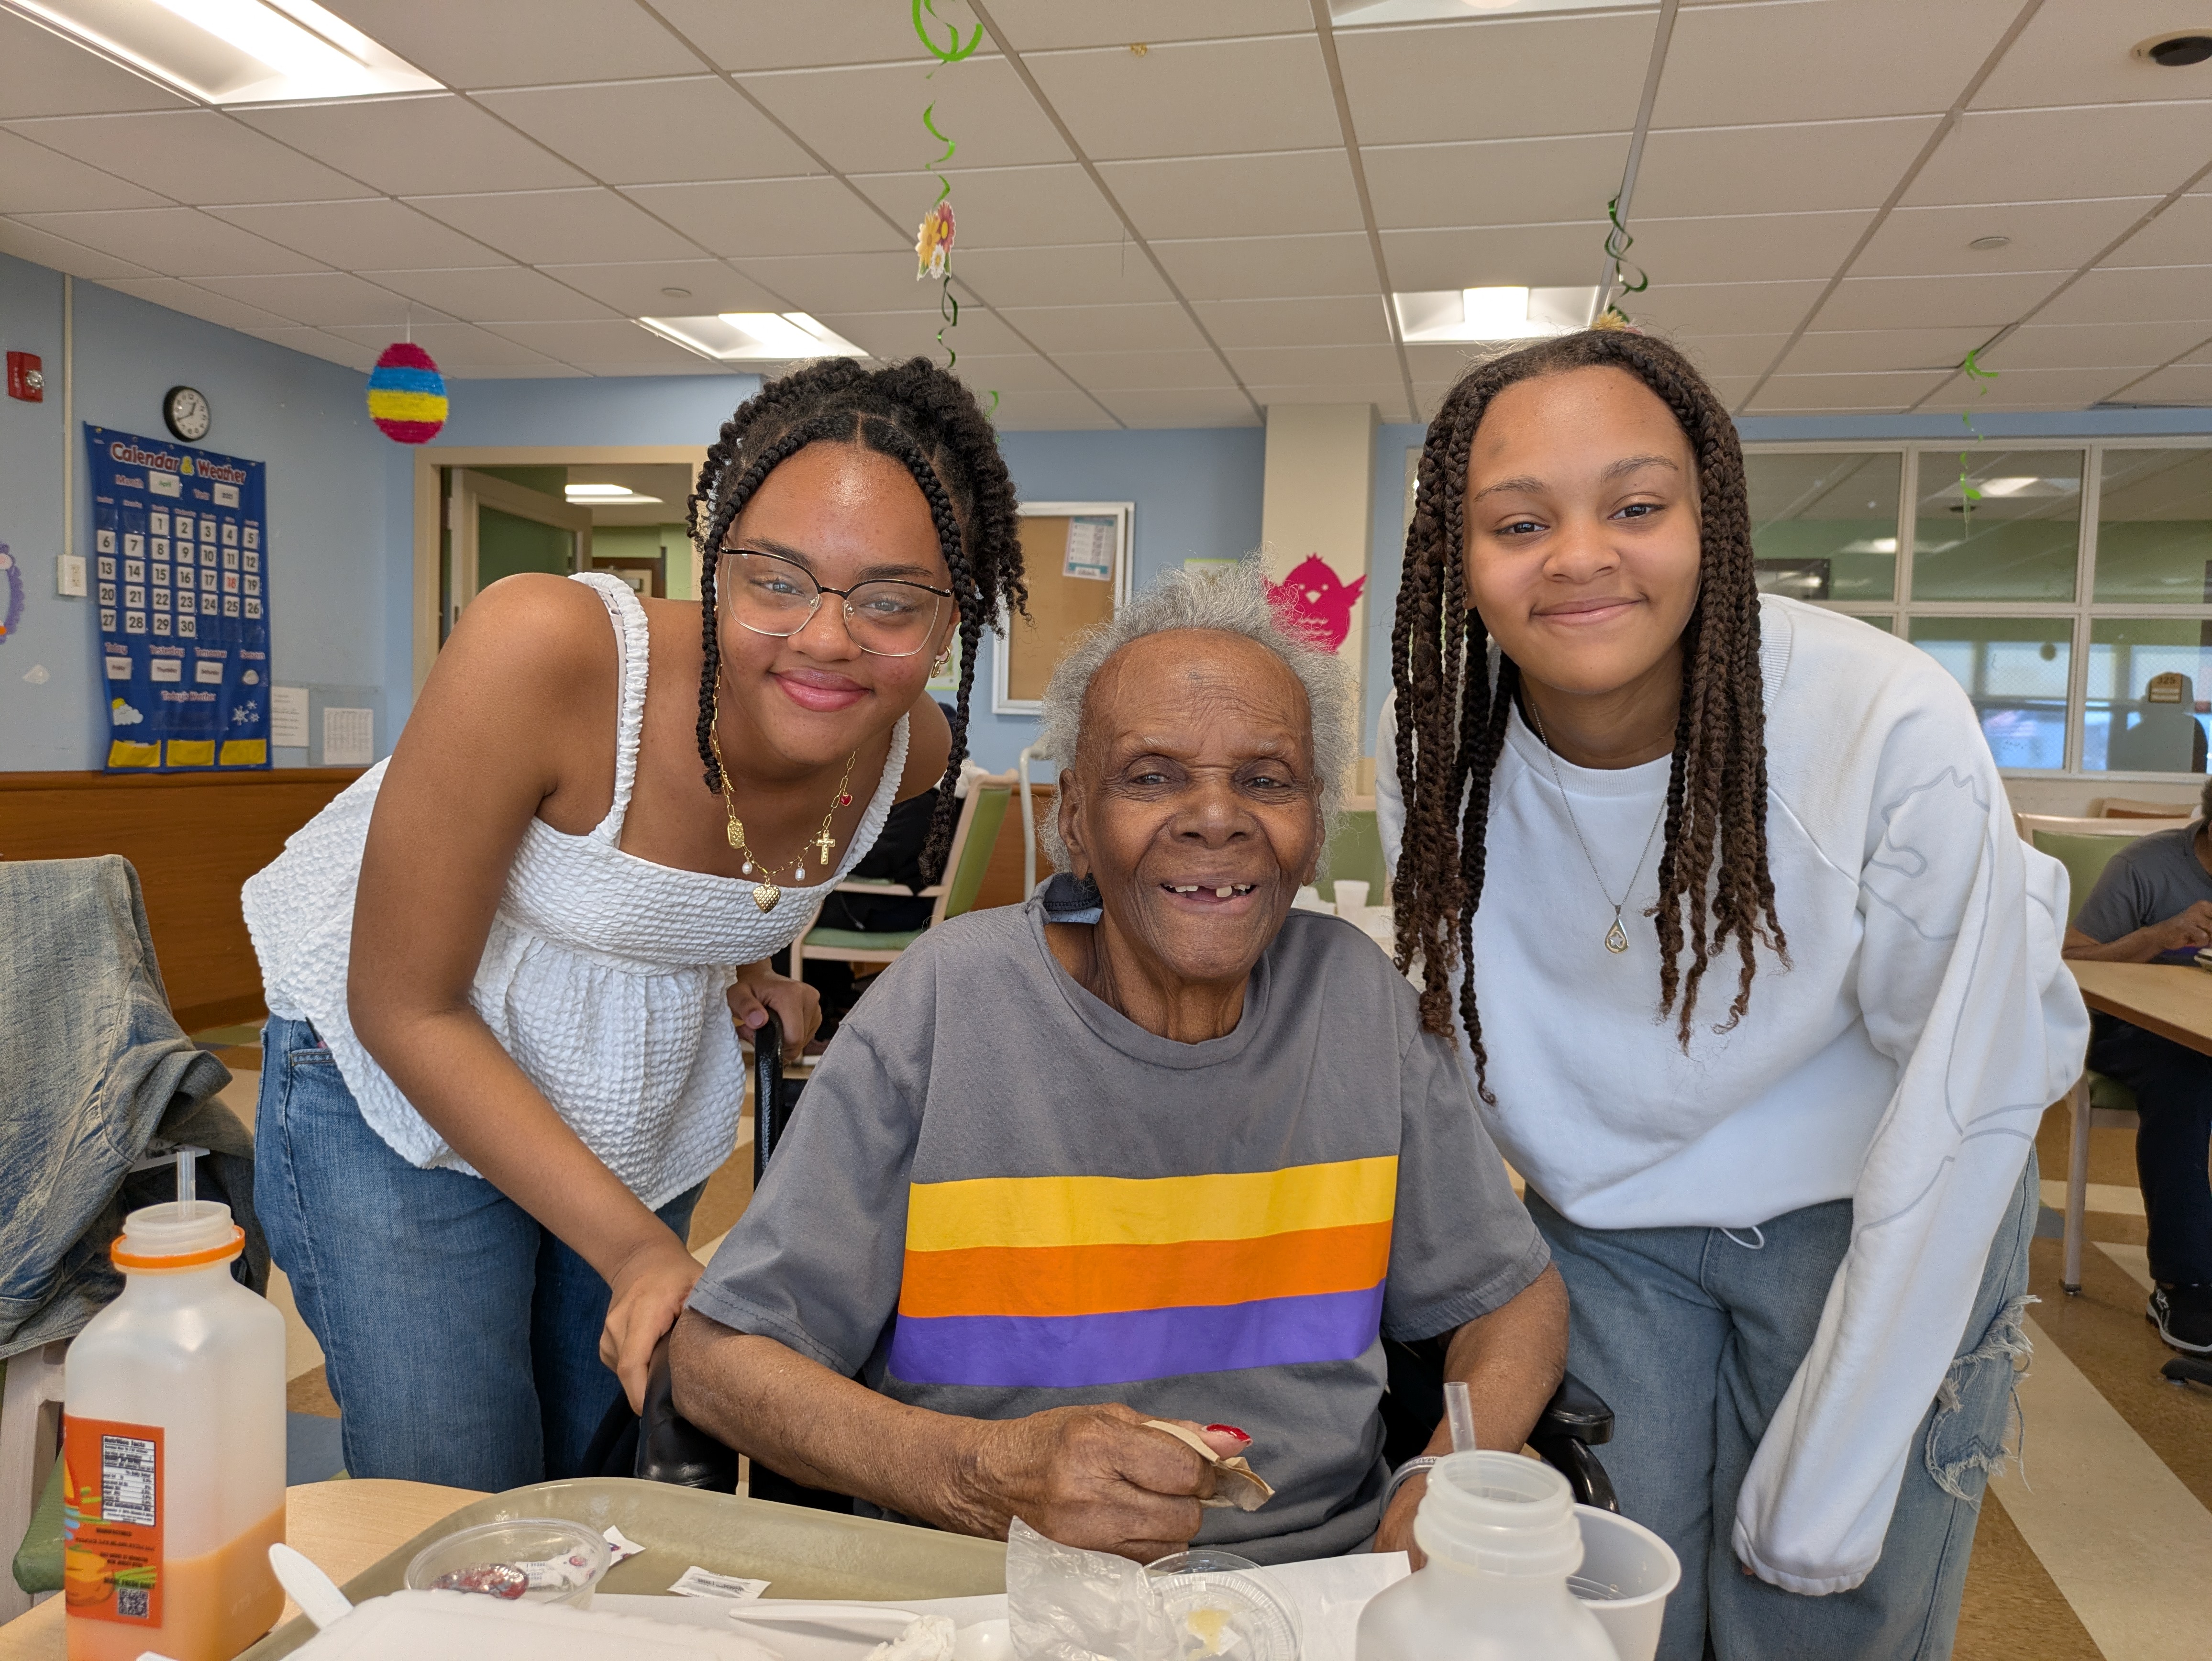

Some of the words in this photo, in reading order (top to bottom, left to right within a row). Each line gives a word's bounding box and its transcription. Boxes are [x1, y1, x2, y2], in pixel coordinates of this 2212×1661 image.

[111, 443, 180, 472] Calendar
[181, 456, 194, 475] &
[197, 459, 246, 484] Weather
[157, 518, 163, 530] 1
[181, 522, 188, 534] 2
[205, 526, 211, 538] 3
[227, 530, 232, 540] 4
[247, 532, 254, 544] 5
[102, 536, 111, 548] 6
[131, 539, 138, 551] 7
[157, 543, 164, 555] 8
[182, 547, 189, 558] 9
[203, 550, 214, 562] 10
[227, 553, 235, 565] 11
[246, 555, 256, 568] 12
[101, 562, 112, 575] 13
[128, 565, 141, 577] 14
[155, 568, 166, 581] 15
[180, 572, 191, 584] 16
[205, 574, 215, 586] 17
[227, 576, 236, 589] 18
[247, 579, 258, 590] 19
[101, 588, 115, 601] 20
[130, 590, 142, 603] 21
[155, 593, 169, 606] 22
[180, 596, 193, 608] 23
[204, 598, 216, 610] 24
[227, 600, 238, 612] 25
[248, 603, 259, 614] 26
[102, 614, 114, 626] 27
[129, 616, 144, 629] 28
[156, 618, 169, 631] 29
[180, 620, 195, 632] 30
